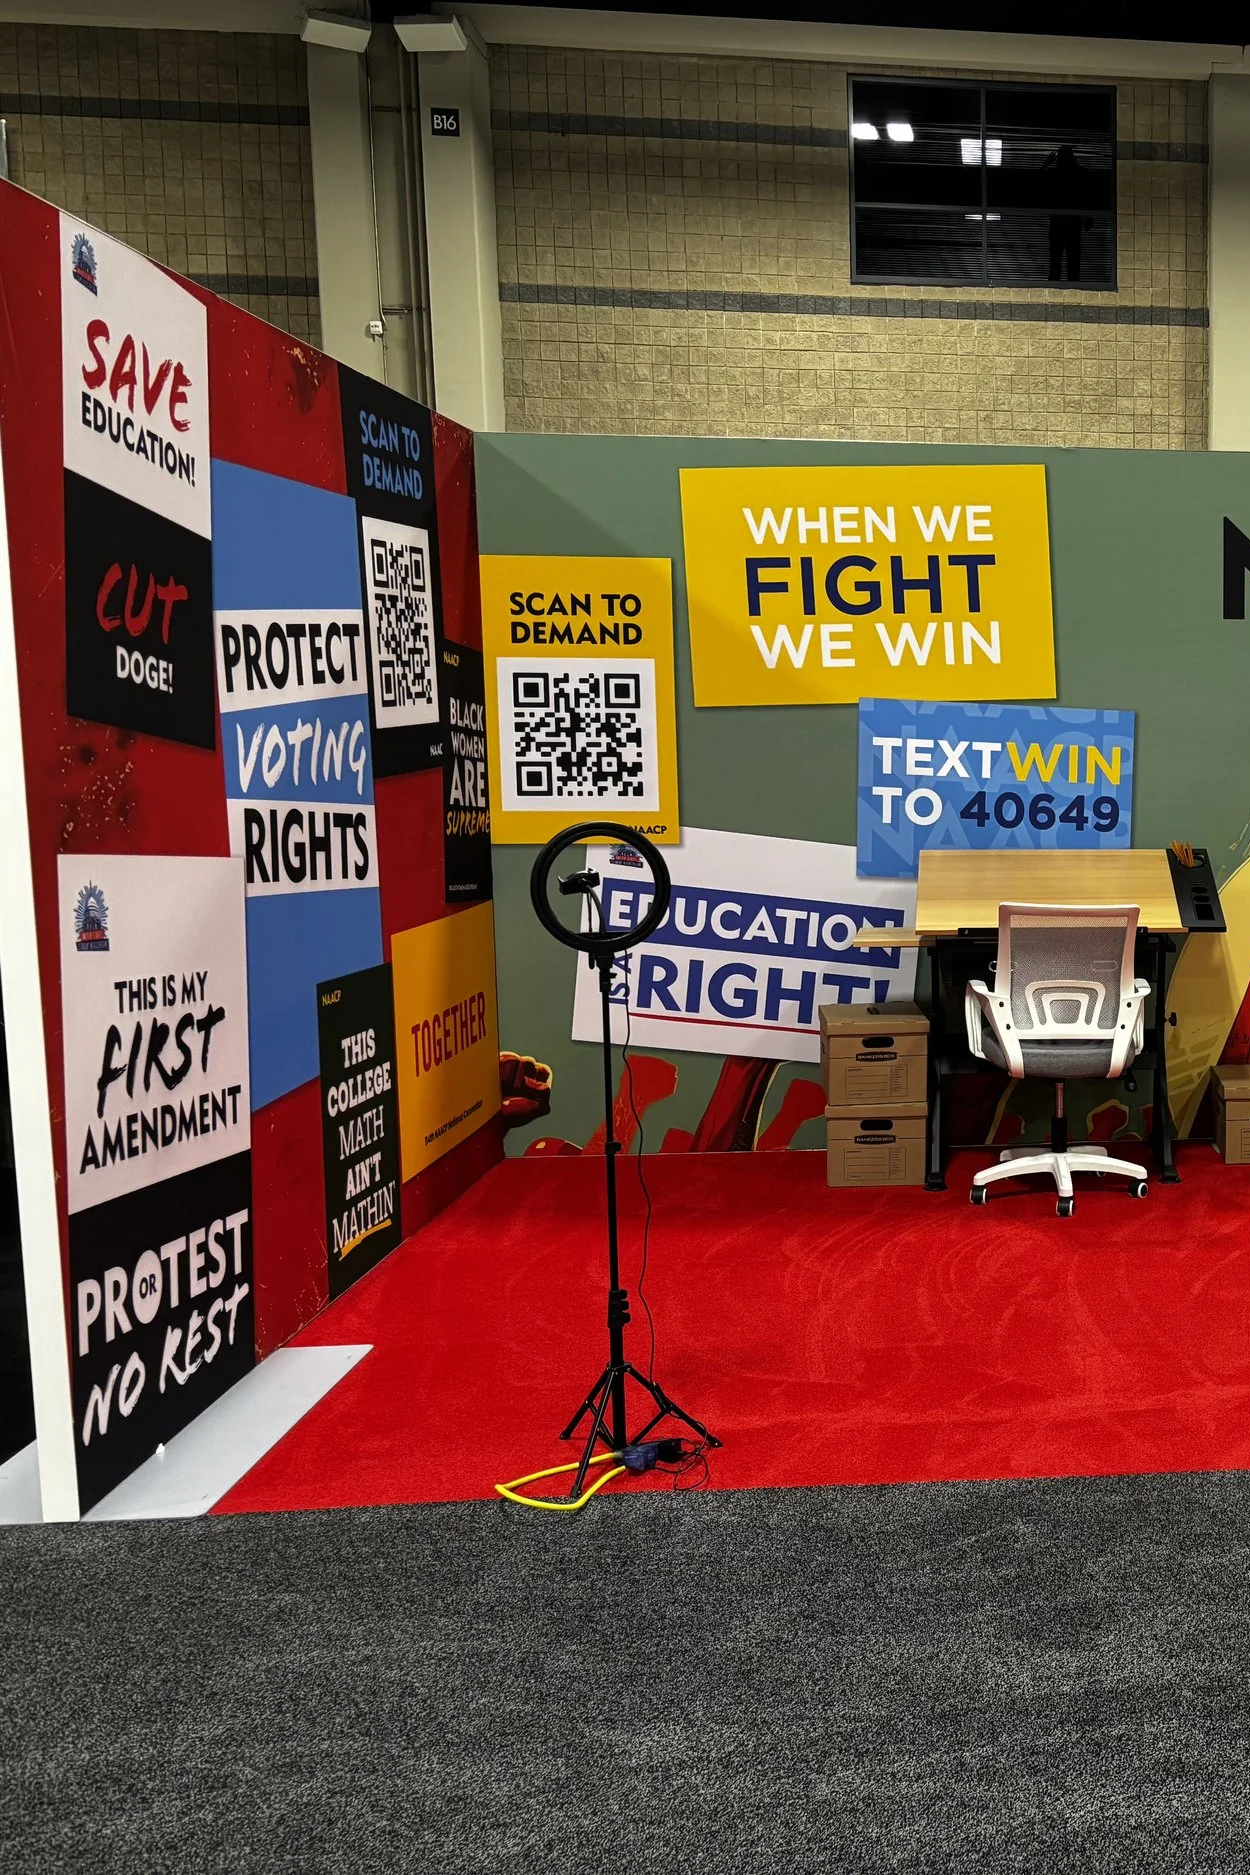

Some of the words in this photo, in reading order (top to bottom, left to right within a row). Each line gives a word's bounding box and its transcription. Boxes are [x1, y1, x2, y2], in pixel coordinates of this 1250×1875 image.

[433, 114, 456, 130] B16
[82, 319, 192, 432] SAVE
[81, 391, 195, 487] EDUCATION!
[359, 409, 399, 455] SCAN
[401, 425, 420, 462] TO
[362, 453, 423, 500] DEMAND
[742, 506, 897, 545] WHEN
[912, 505, 994, 543] WE
[96, 562, 188, 644] CUT
[509, 592, 591, 617] SCAN
[601, 594, 642, 617] TO
[745, 554, 996, 616] FIGHT
[221, 622, 360, 692] PROTECT
[510, 621, 643, 646] DEMAND
[749, 622, 856, 669] WE
[874, 620, 1001, 666] WIN
[116, 645, 173, 694] DOGE!
[450, 697, 484, 732] BLACK
[236, 717, 366, 796] VOTING
[429, 743, 443, 756] NAAC
[451, 731, 484, 759] WOMEN
[872, 736, 1001, 778] TEXT
[1005, 741, 1121, 785] WIN
[450, 756, 486, 808] ARE
[447, 810, 490, 837] SUPREME
[872, 786, 943, 826] TO
[960, 791, 1120, 832] 40649
[244, 808, 369, 883] RIGHTS
[612, 952, 632, 975] A
[114, 976, 157, 1014] THIS
[162, 974, 175, 1008] IS
[181, 970, 208, 1005] MY
[322, 990, 341, 1006] NAACP
[341, 1028, 375, 1069] THIS
[411, 991, 487, 1078] TOGETHER
[97, 1004, 226, 1119] FIRST
[327, 1061, 391, 1117] COLLEGE
[79, 1084, 241, 1174] AMENDMENT
[338, 1104, 385, 1160] MATH
[346, 1151, 381, 1200] AIN'T
[332, 1180, 395, 1254] MATHIN'
[77, 1208, 248, 1357] PROTEST
[139, 1274, 157, 1299] OR
[82, 1352, 146, 1447] NO
[159, 1283, 249, 1394] REST
